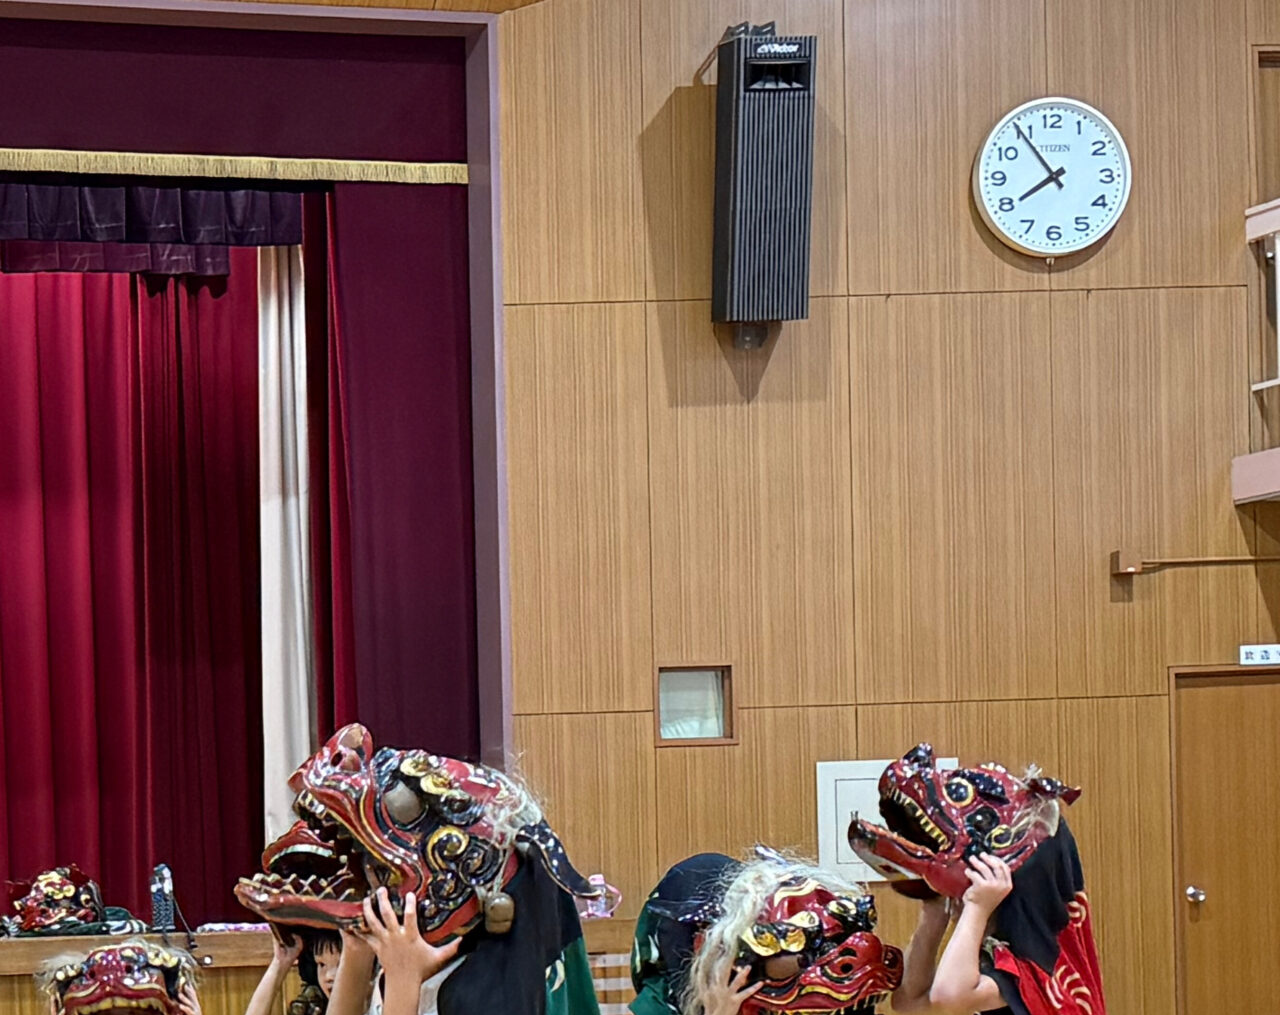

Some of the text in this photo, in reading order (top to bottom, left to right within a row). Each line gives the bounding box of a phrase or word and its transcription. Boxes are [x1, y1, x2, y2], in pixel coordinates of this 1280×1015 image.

[767, 43, 800, 53] Victor
[1042, 114, 1062, 129] 12
[1076, 120, 1082, 135] 1
[998, 146, 1018, 161] 10
[1091, 141, 1106, 156] 2
[991, 171, 1007, 186] 9
[1099, 168, 1115, 184] 3
[998, 197, 1015, 212] 8
[1091, 194, 1108, 209] 4
[1020, 219, 1035, 234] 7
[1074, 216, 1090, 231] 5
[1046, 226, 1062, 241] 6
